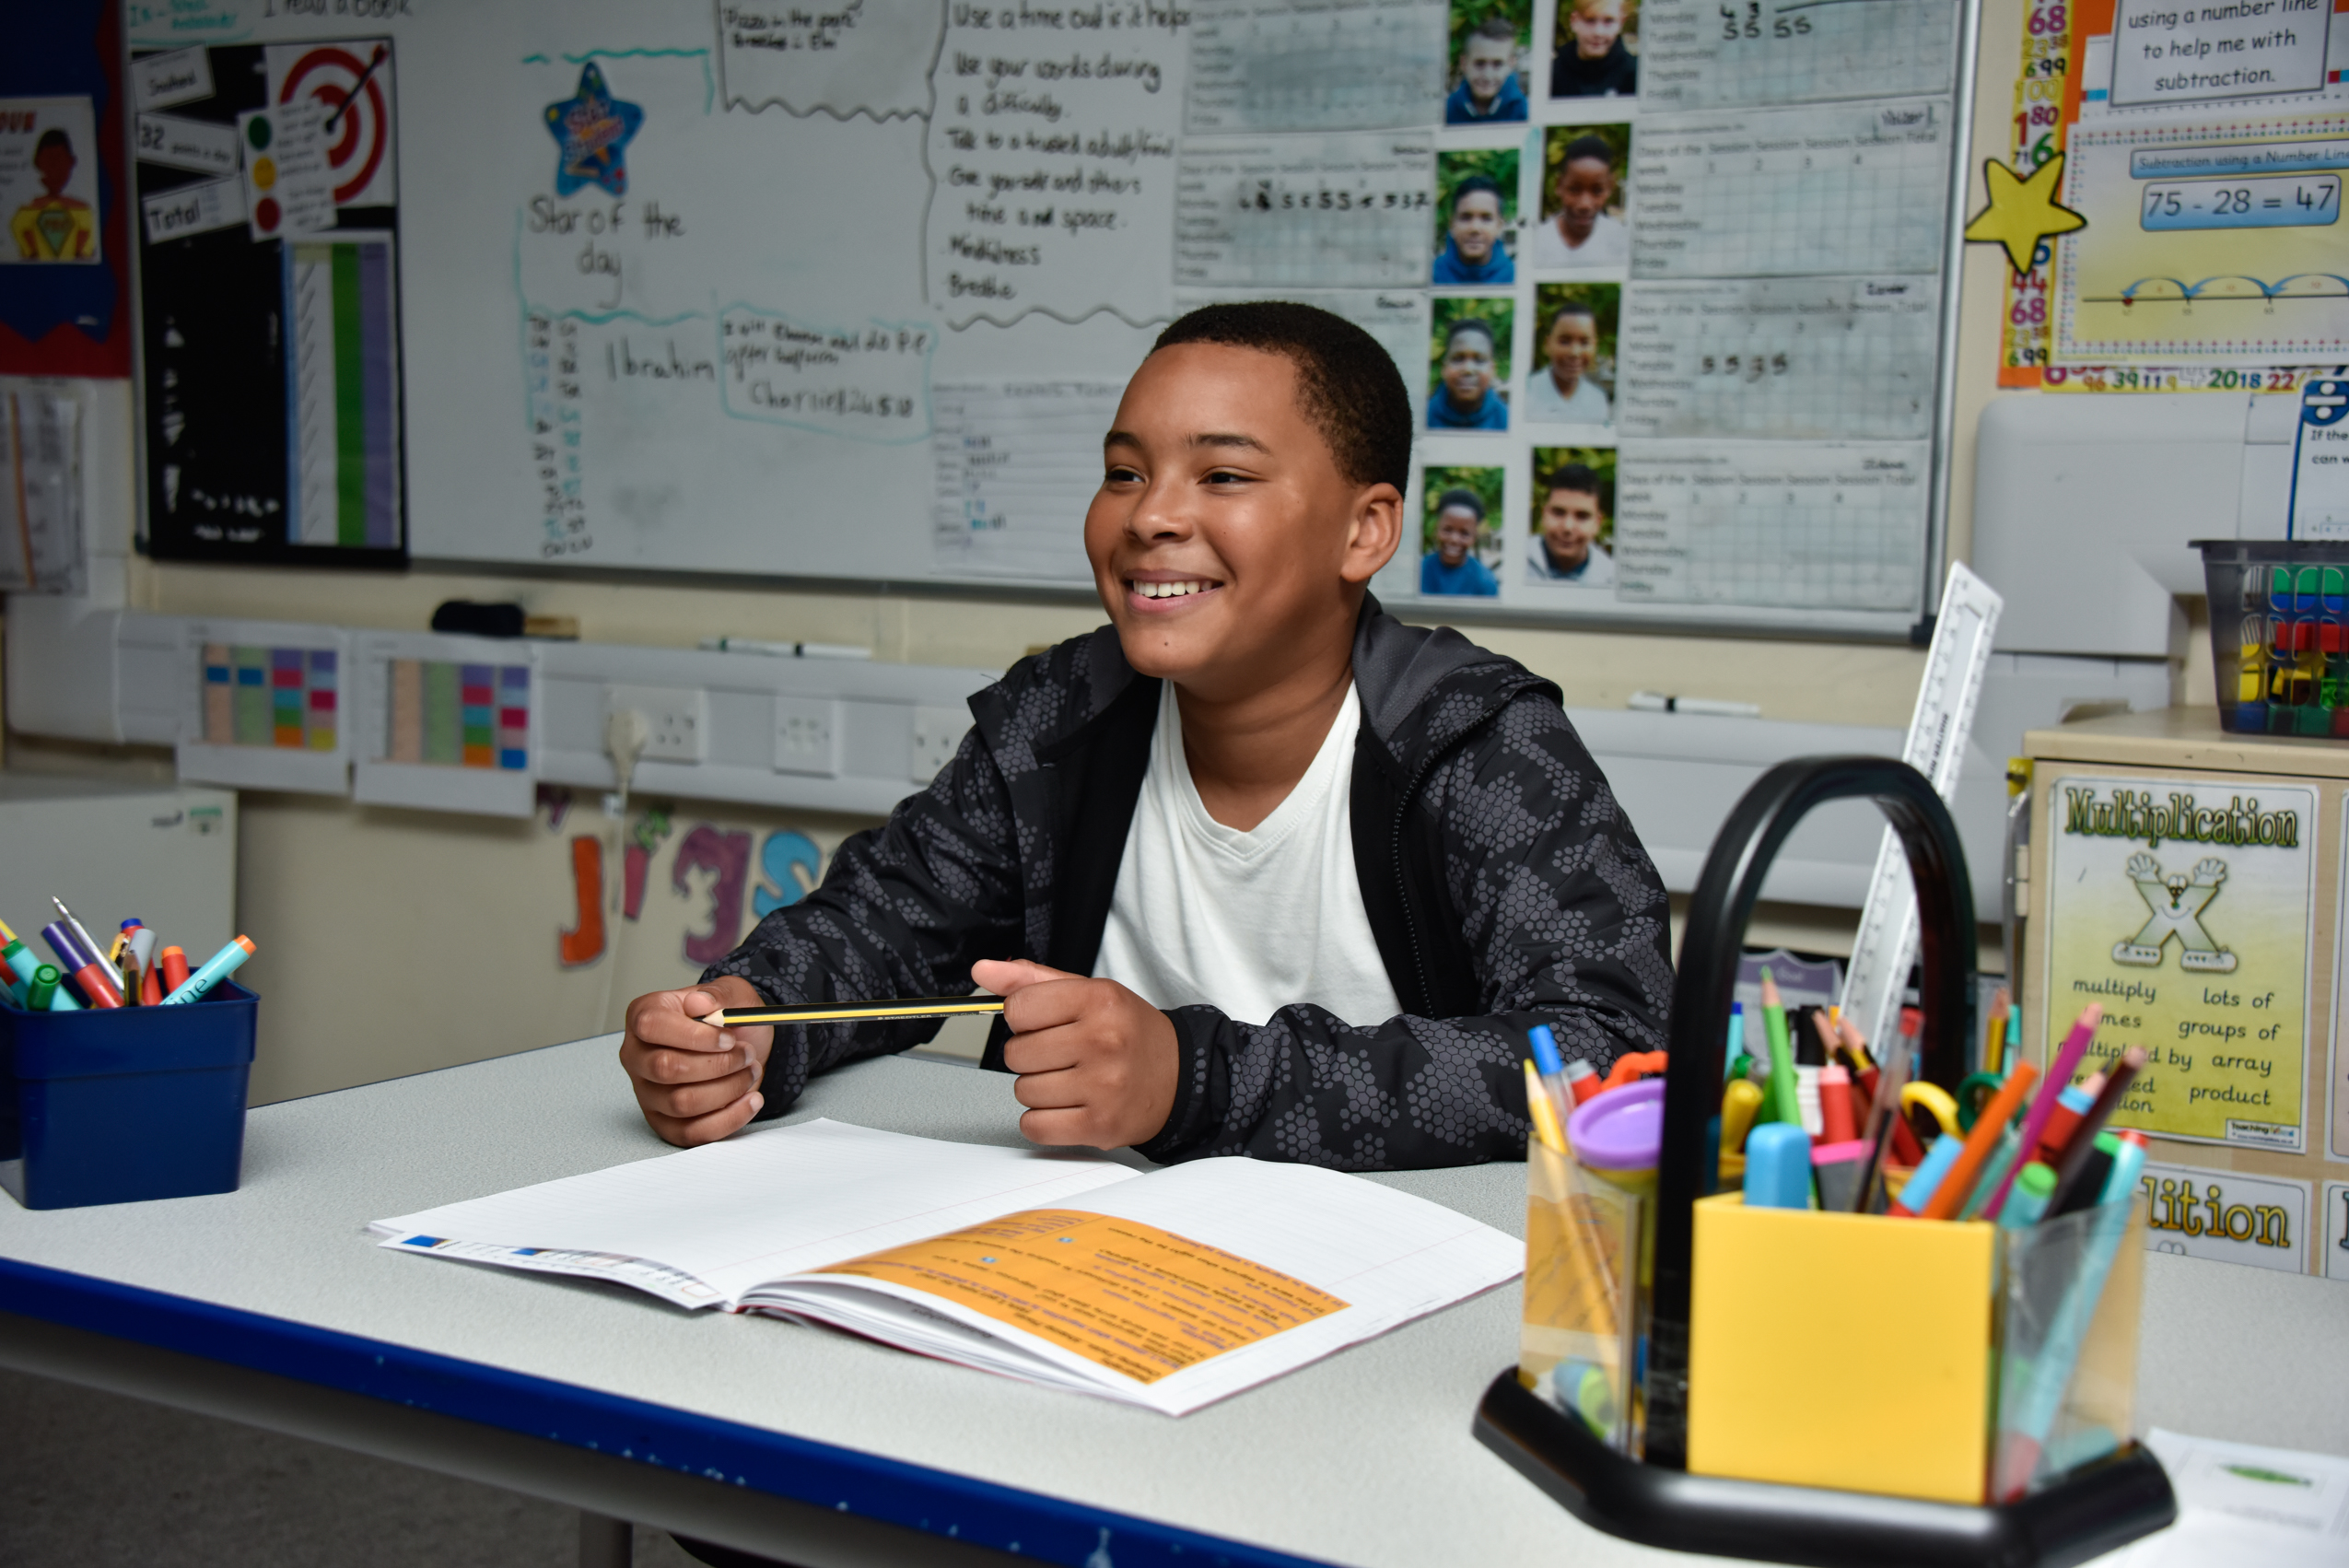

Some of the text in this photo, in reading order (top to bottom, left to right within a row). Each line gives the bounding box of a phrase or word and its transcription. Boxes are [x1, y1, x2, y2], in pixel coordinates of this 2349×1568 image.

[2028, 5, 2067, 36] 68
[2129, 10, 2178, 30] using
[2183, 11, 2195, 24] a
[2201, 0, 2275, 22] number
[2143, 29, 2297, 61] to help me with
[2039, 57, 2066, 76] 99
[2155, 65, 2277, 91] subtraction.
[2030, 105, 2060, 126] 80
[2138, 153, 2211, 170] Subtraction
[2215, 153, 2249, 170] using
[2252, 154, 2262, 165] a
[2266, 149, 2320, 164] Number
[2147, 190, 2183, 218] 75
[2212, 188, 2252, 216] 28
[2295, 183, 2335, 212] 47
[149, 197, 201, 232] Total
[528, 193, 687, 241] Star of the
[575, 240, 624, 310] day
[2009, 298, 2046, 326] 68
[2112, 370, 2138, 389] 39
[2207, 369, 2238, 389] 20
[2240, 372, 2262, 389] 18
[2266, 372, 2295, 392] 22
[2064, 787, 2298, 848] Multiplication
[2073, 977, 2156, 1005] multiply
[2203, 987, 2275, 1010] lots of
[2178, 1020, 2282, 1044] groups of
[2168, 1047, 2192, 1072] by
[2211, 1054, 2273, 1079] array
[2189, 1083, 2272, 1106] product
